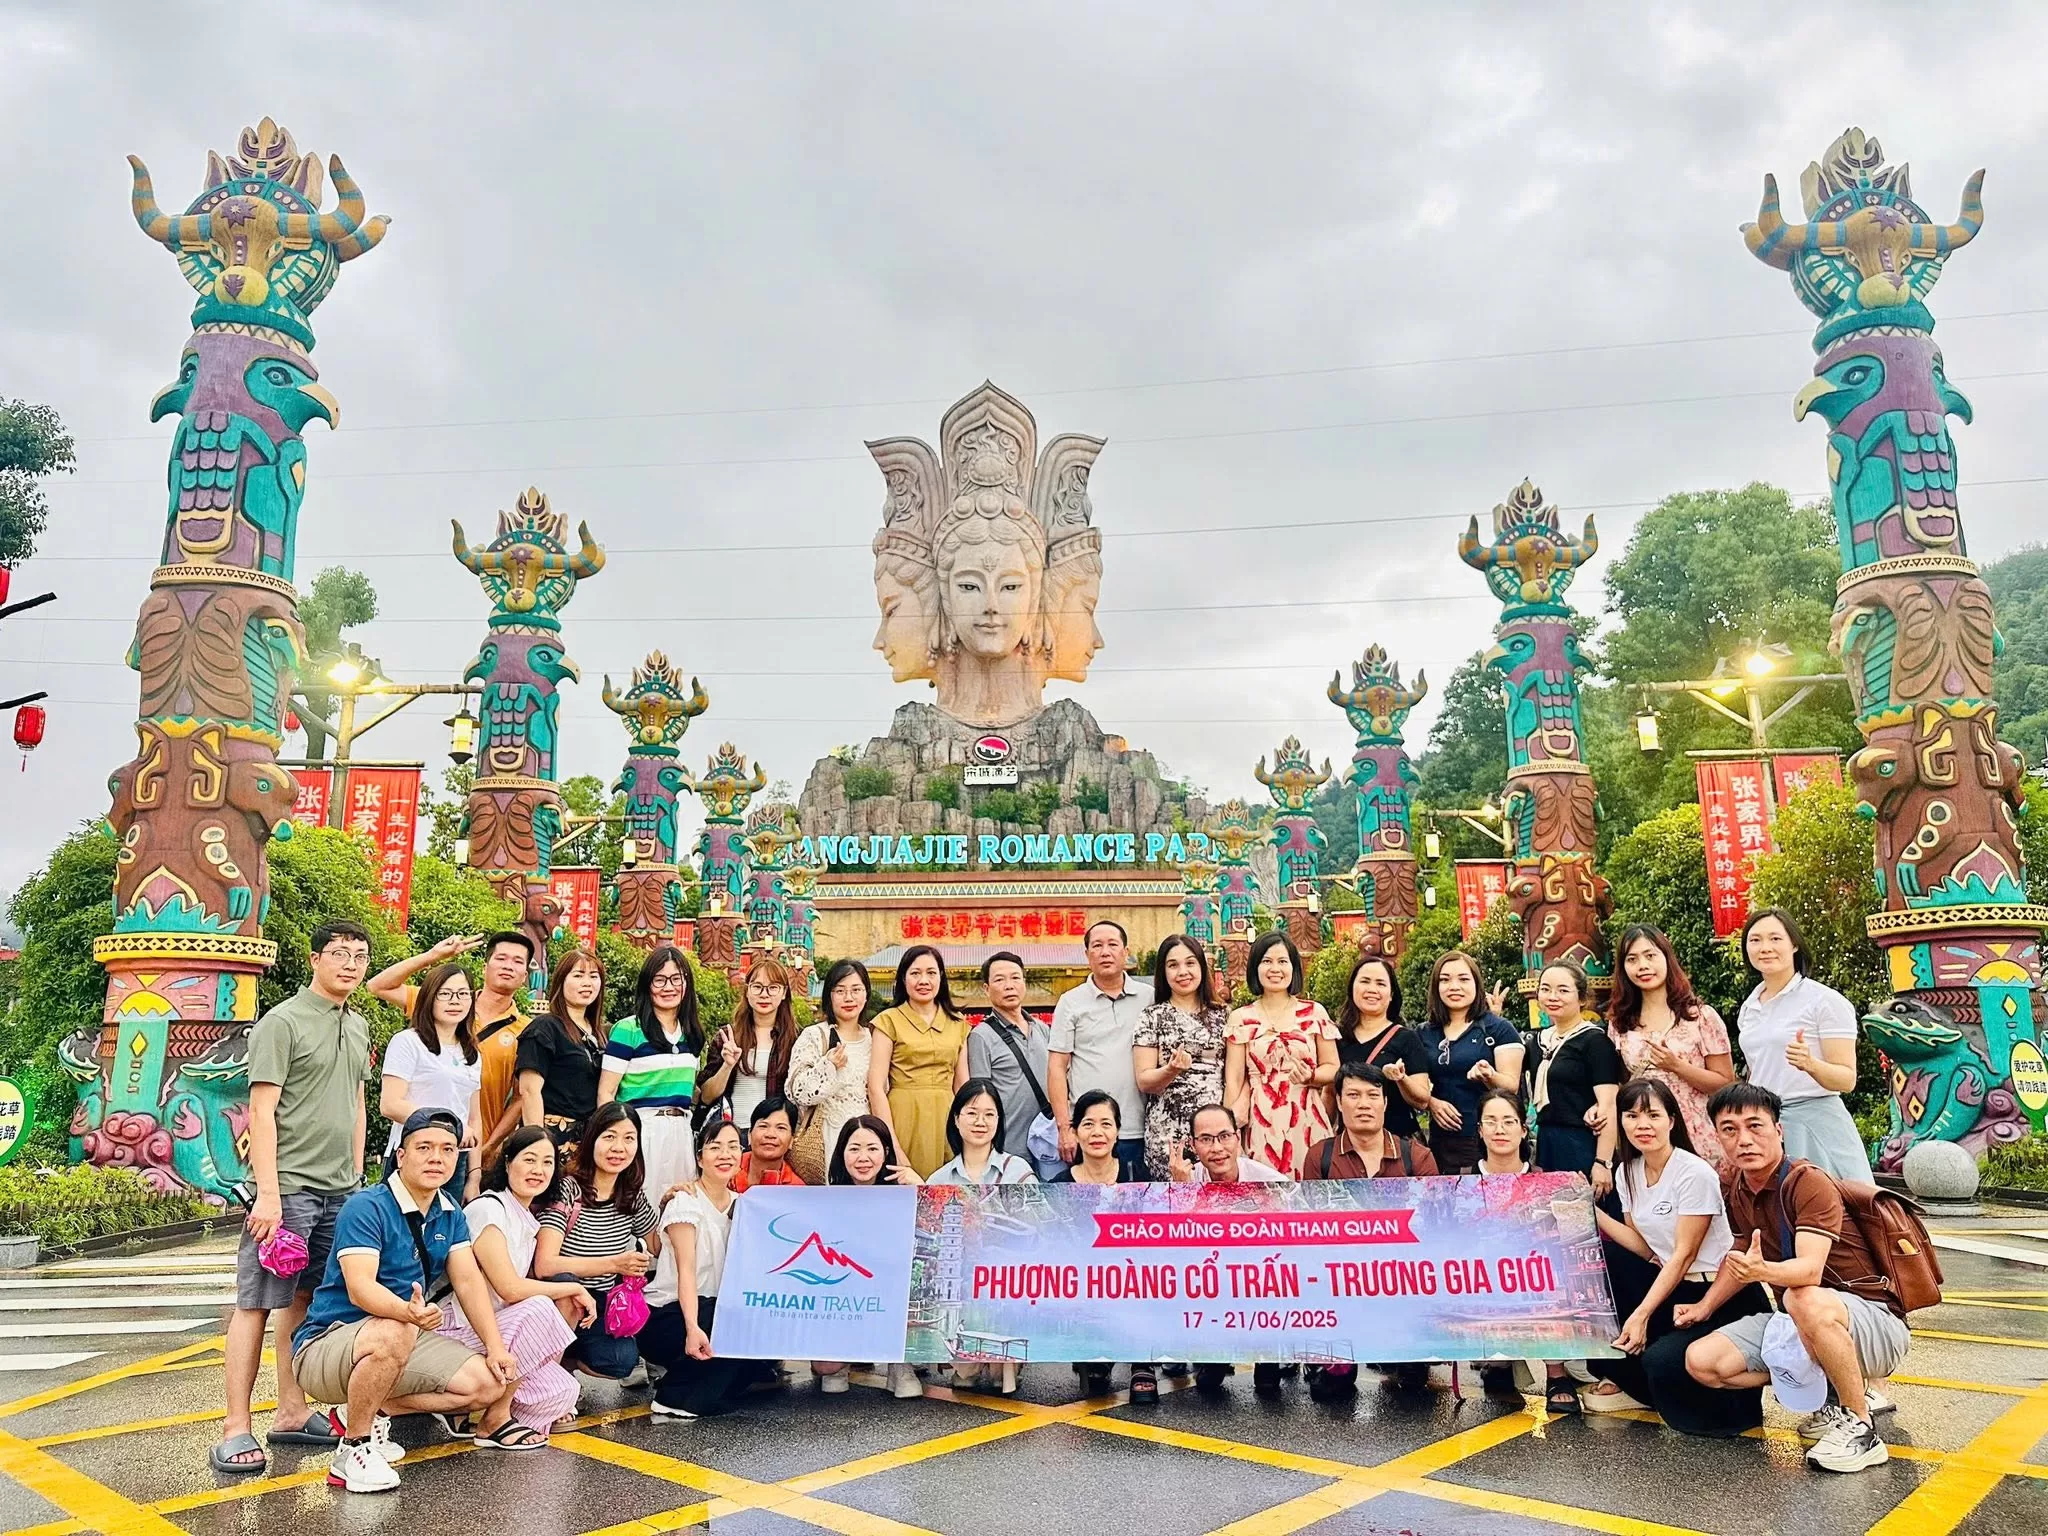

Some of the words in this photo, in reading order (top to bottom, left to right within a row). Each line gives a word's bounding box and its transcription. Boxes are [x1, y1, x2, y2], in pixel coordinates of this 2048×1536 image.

[381, 798, 411, 918] 一生必看的演
[783, 835, 968, 865] ANGJIAJIE
[977, 833, 1136, 864] ROMANCE
[1109, 1219, 1164, 1239] CHÀO
[1168, 1217, 1224, 1239] MỪNG
[1229, 1217, 1285, 1239] ĐOÀN
[1288, 1220, 1340, 1237] THAM
[1343, 1218, 1400, 1236] QUAN
[972, 1263, 1079, 1305] PHƯỢNG
[1087, 1258, 1177, 1300] HOÀNG
[1184, 1249, 1220, 1300] CỔ
[1225, 1252, 1300, 1299] TRẤN
[1325, 1259, 1438, 1298] TRƯƠNG
[1443, 1256, 1493, 1295] GIA
[1497, 1250, 1556, 1293] GIỚI
[742, 1291, 816, 1312] THAIAN
[820, 1295, 886, 1313] TRAVEL
[769, 1309, 863, 1321] thaiantravel.com
[1183, 1311, 1203, 1329] 17
[1224, 1310, 1338, 1331] 21/06/2025
